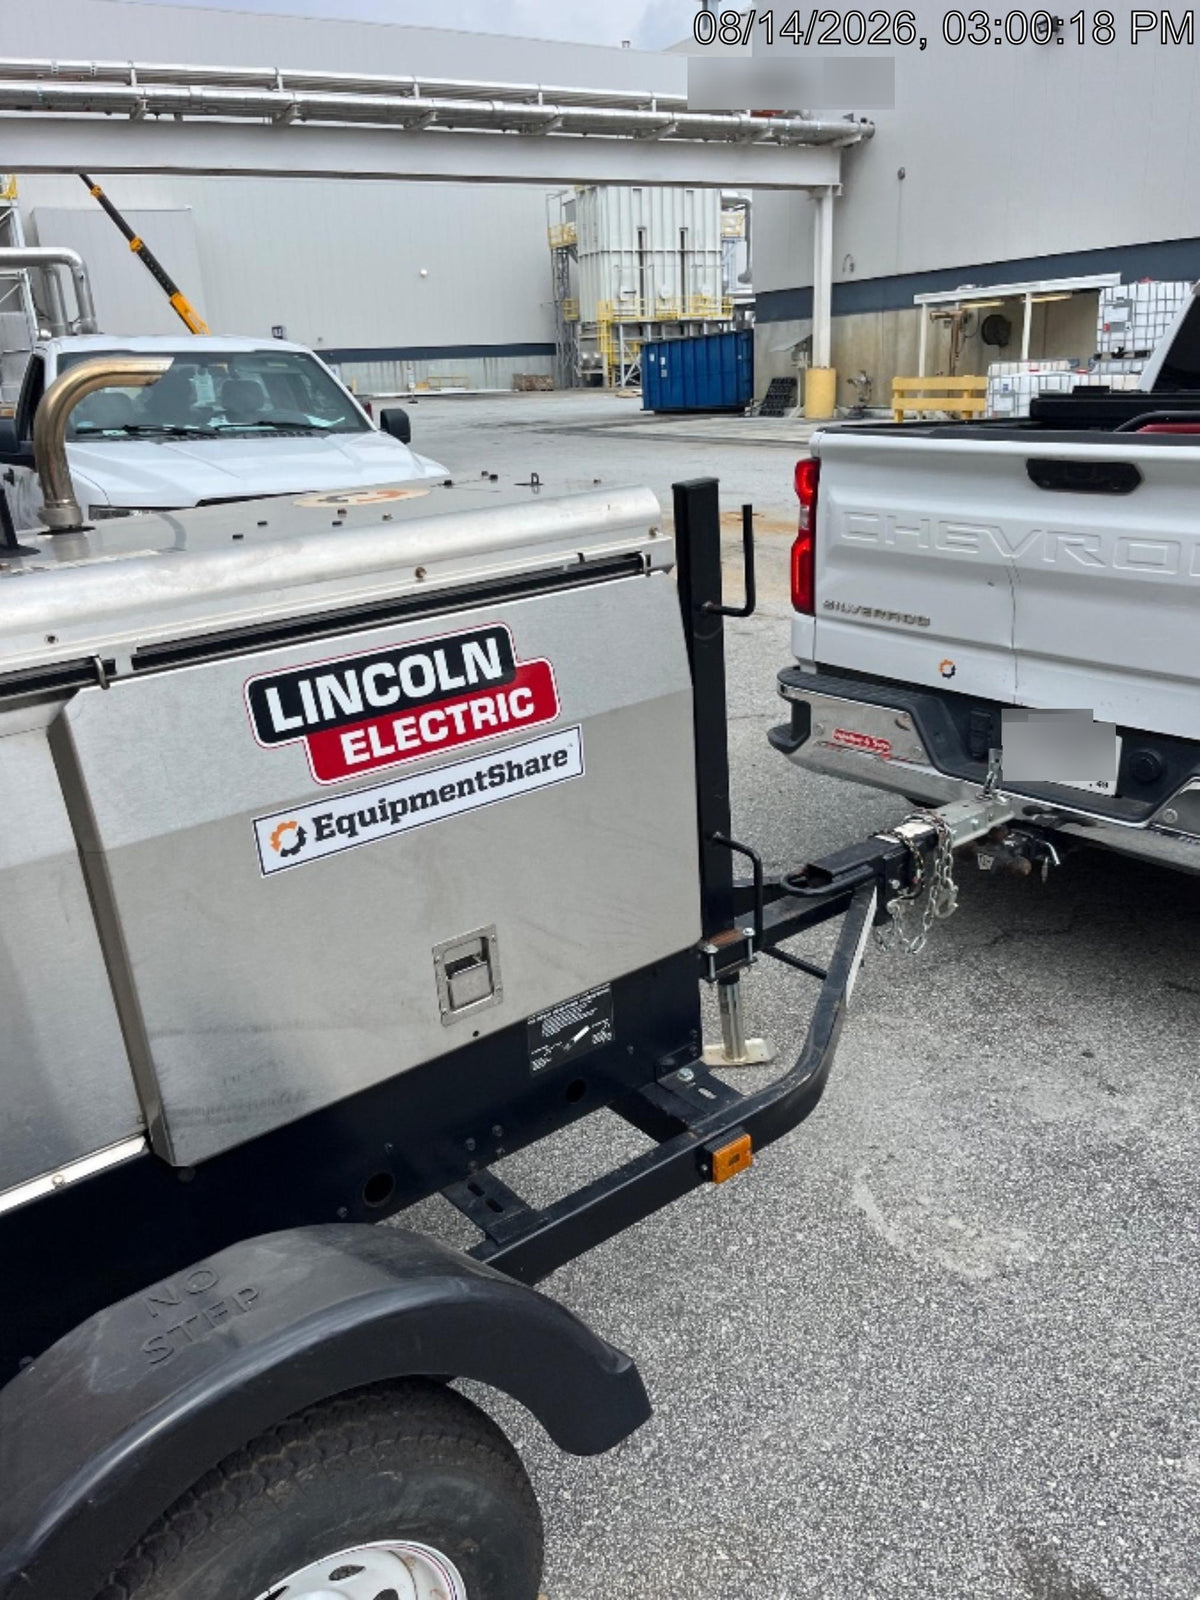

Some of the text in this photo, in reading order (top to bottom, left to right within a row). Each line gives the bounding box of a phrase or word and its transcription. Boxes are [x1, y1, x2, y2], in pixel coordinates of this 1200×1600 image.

[841, 510, 1200, 577] CHEVRO
[265, 637, 504, 733] LINCOLN
[340, 687, 536, 765] ELECTRIC
[311, 749, 569, 843] EquipmentShare
[142, 1285, 260, 1366] STEP
[145, 1268, 220, 1318] NO
